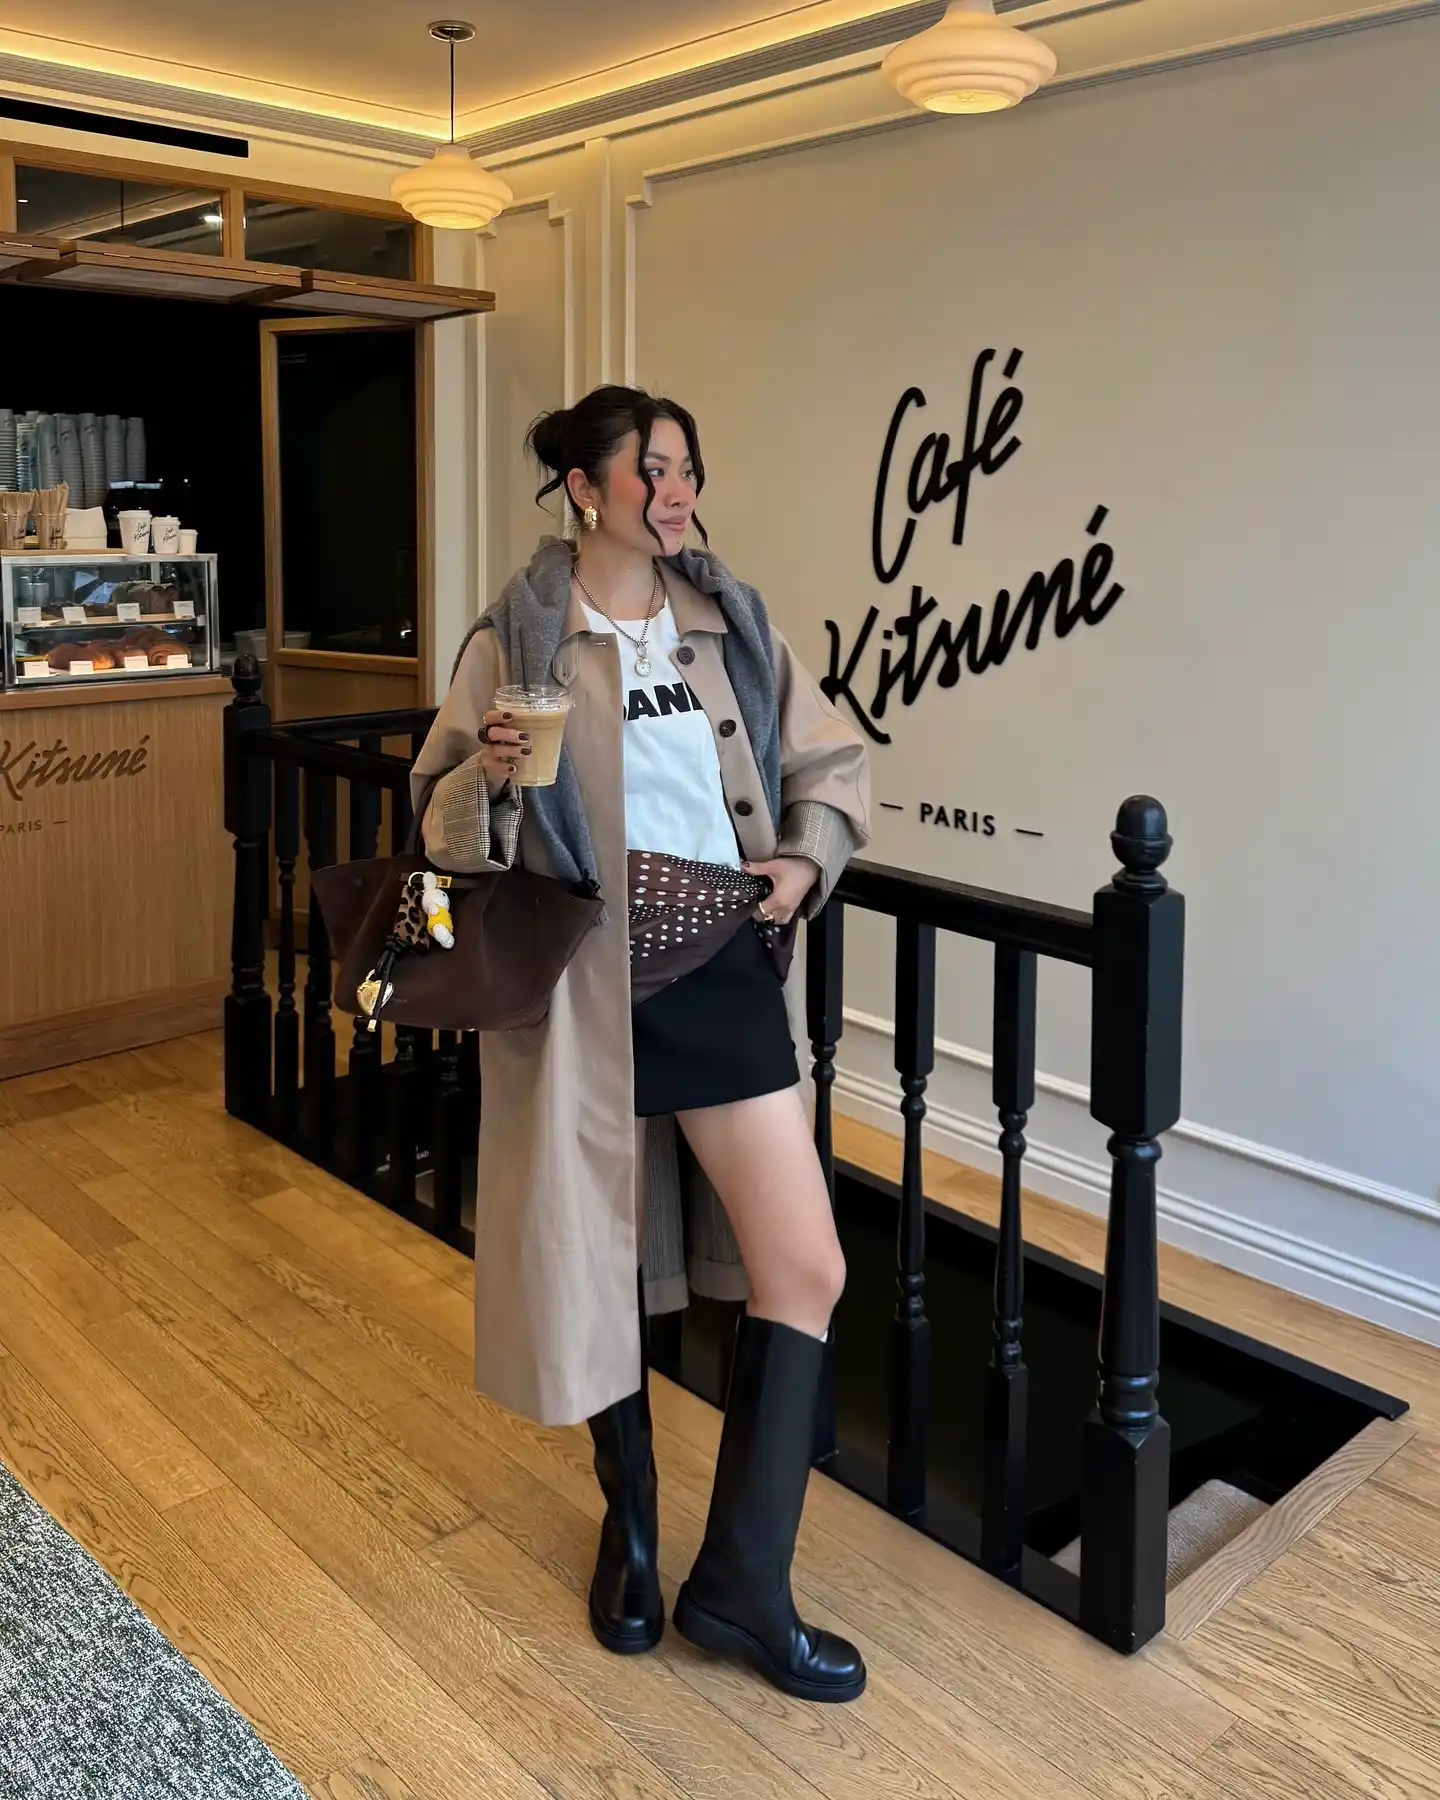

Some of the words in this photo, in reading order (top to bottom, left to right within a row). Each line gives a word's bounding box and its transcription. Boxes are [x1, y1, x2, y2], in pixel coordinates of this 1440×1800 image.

[872, 347, 1024, 583] Café
[820, 504, 1125, 744] Kitsuné
[0, 735, 150, 801] Kitsuné
[920, 802, 995, 836] PARIS
